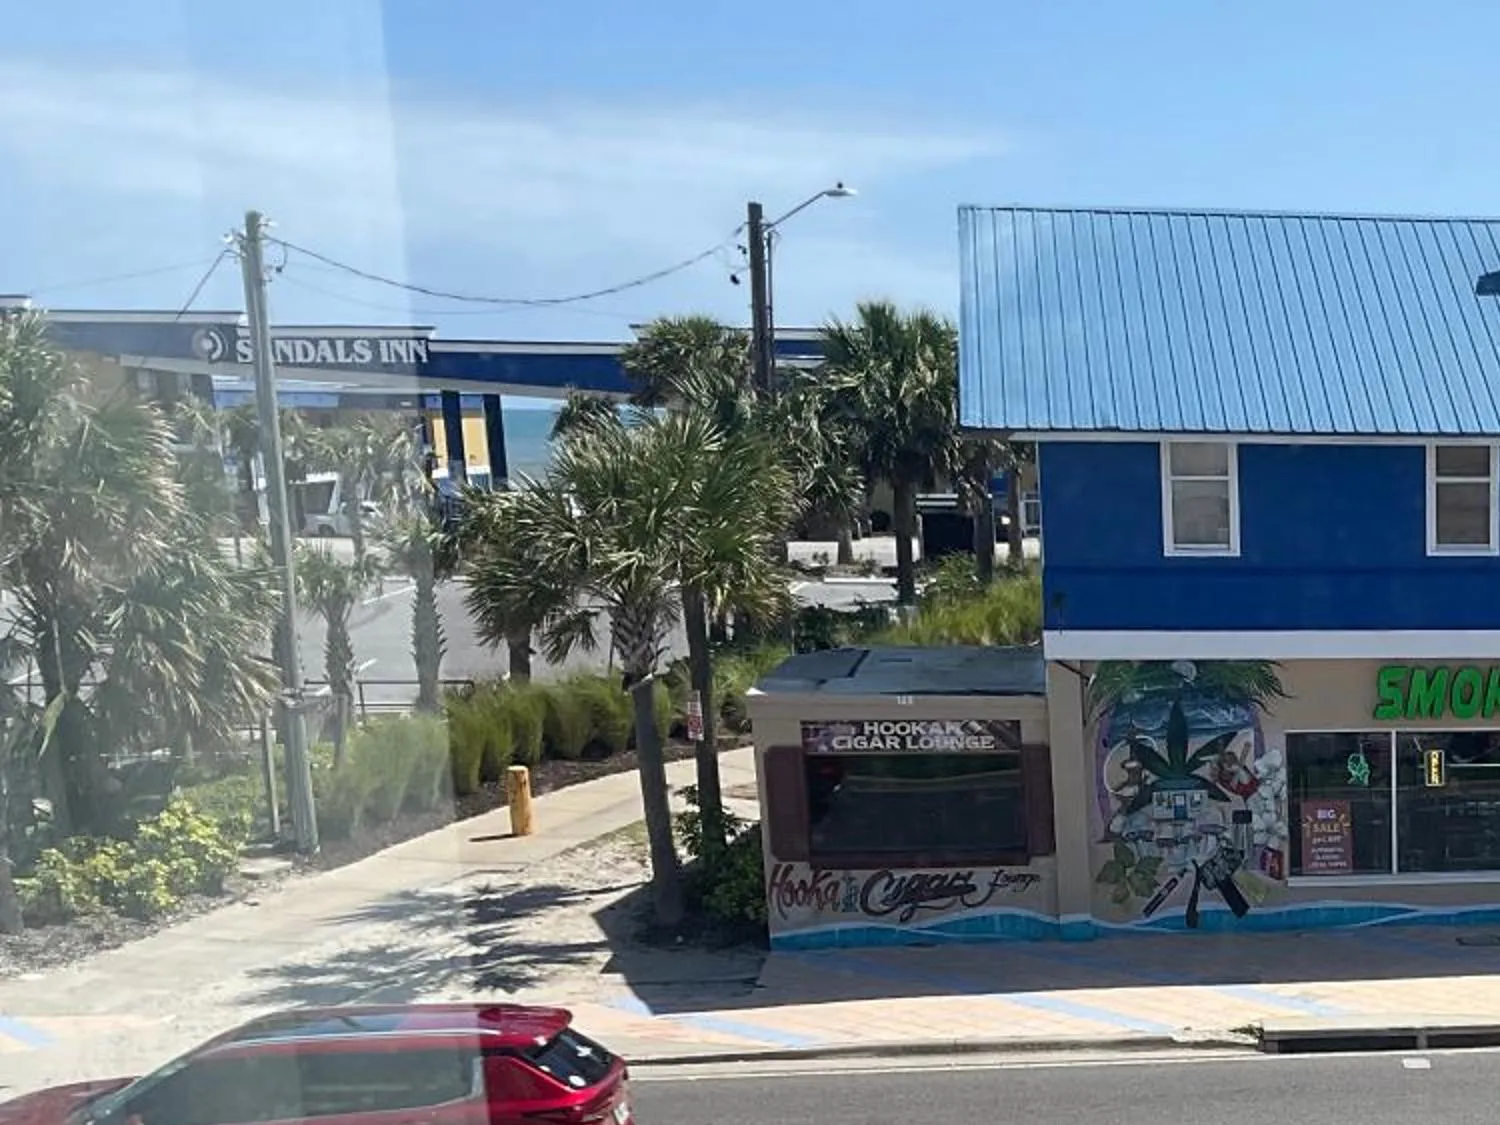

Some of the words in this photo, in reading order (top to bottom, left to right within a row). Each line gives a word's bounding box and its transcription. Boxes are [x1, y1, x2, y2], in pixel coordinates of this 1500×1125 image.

[236, 337, 373, 364] SNDALS
[379, 338, 429, 364] INN
[832, 735, 901, 750] CIGAR
[906, 735, 996, 751] LOUNGE
[1312, 822, 1341, 833] SALE
